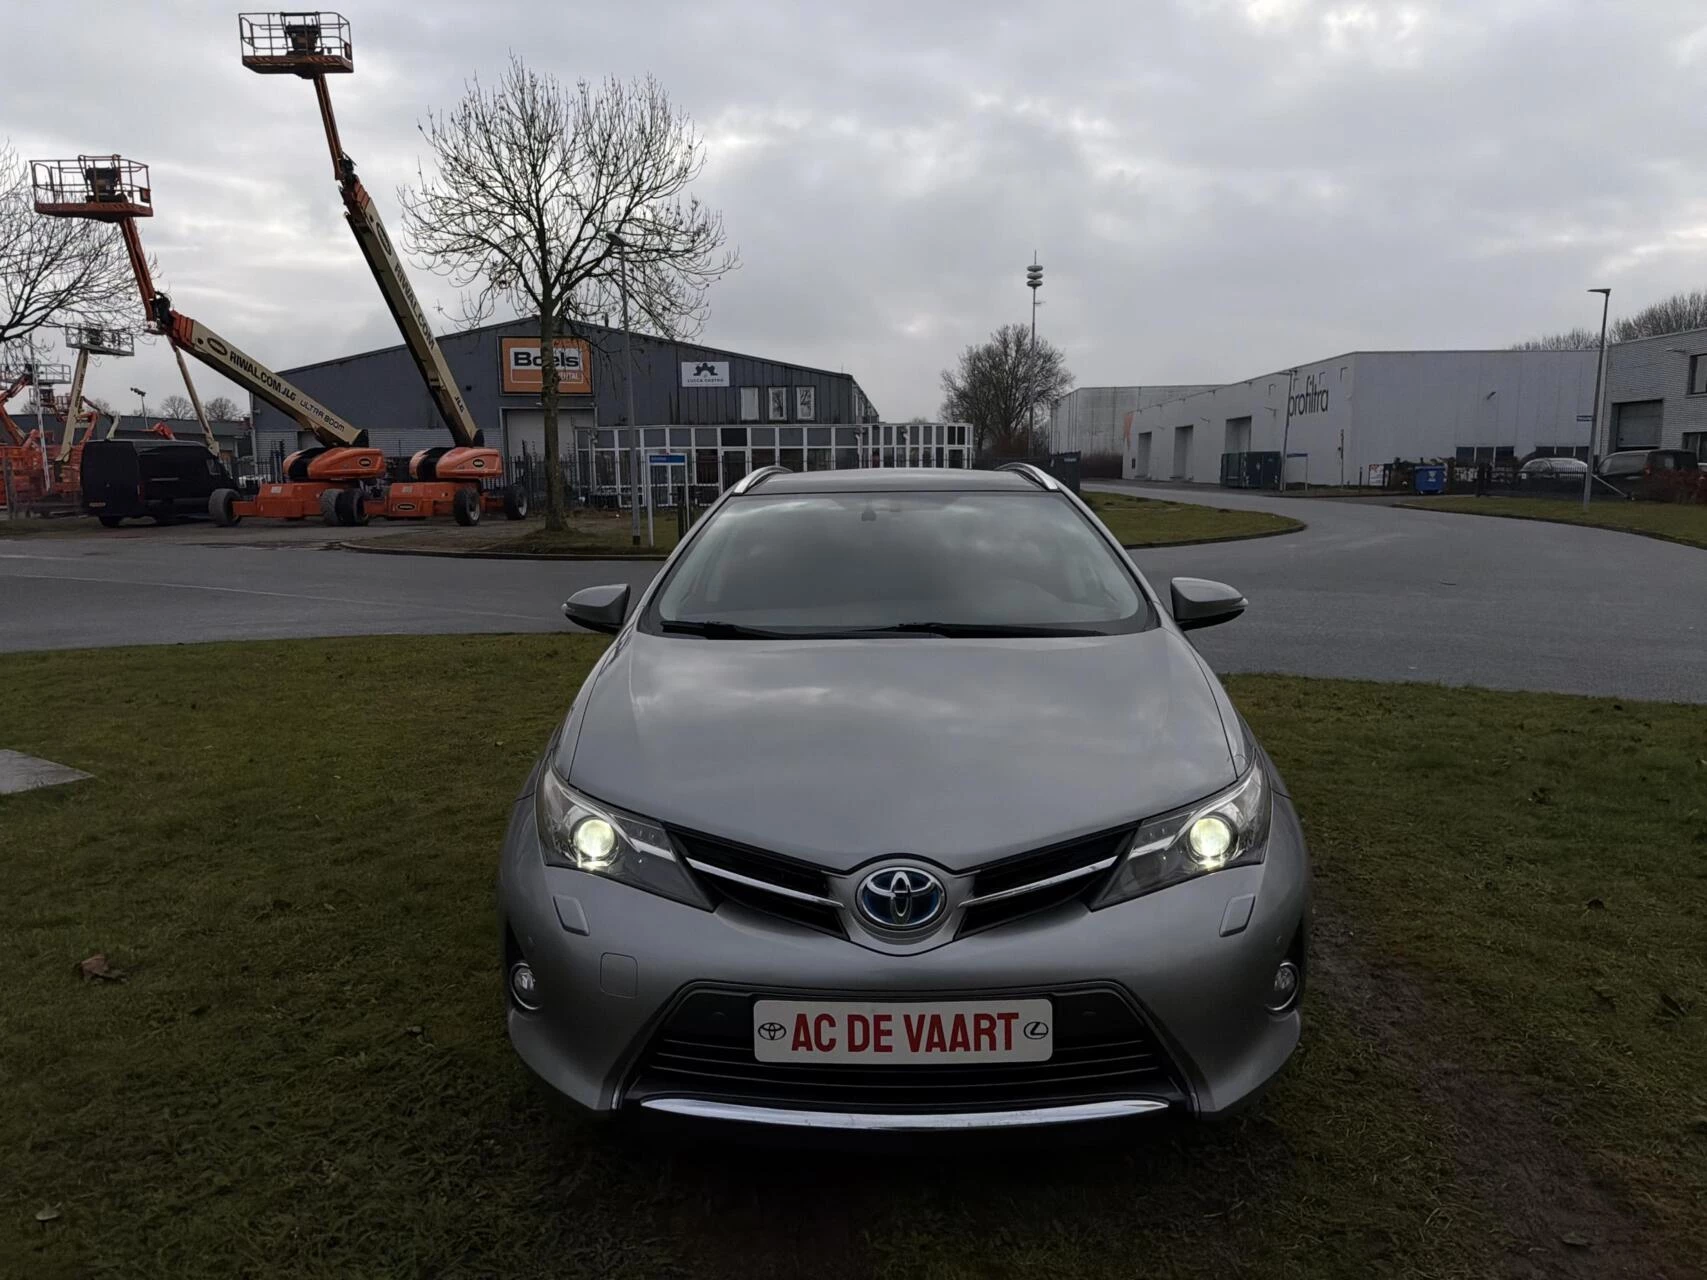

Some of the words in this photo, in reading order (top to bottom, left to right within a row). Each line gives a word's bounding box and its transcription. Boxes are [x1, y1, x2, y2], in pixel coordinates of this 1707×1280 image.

[229, 351, 282, 393] RIWAL.COM
[300, 399, 324, 419] ULTRA
[323, 413, 346, 432] BOOM
[791, 1013, 837, 1052] AC
[847, 1013, 893, 1053] DE
[903, 1012, 1019, 1053] VAART
